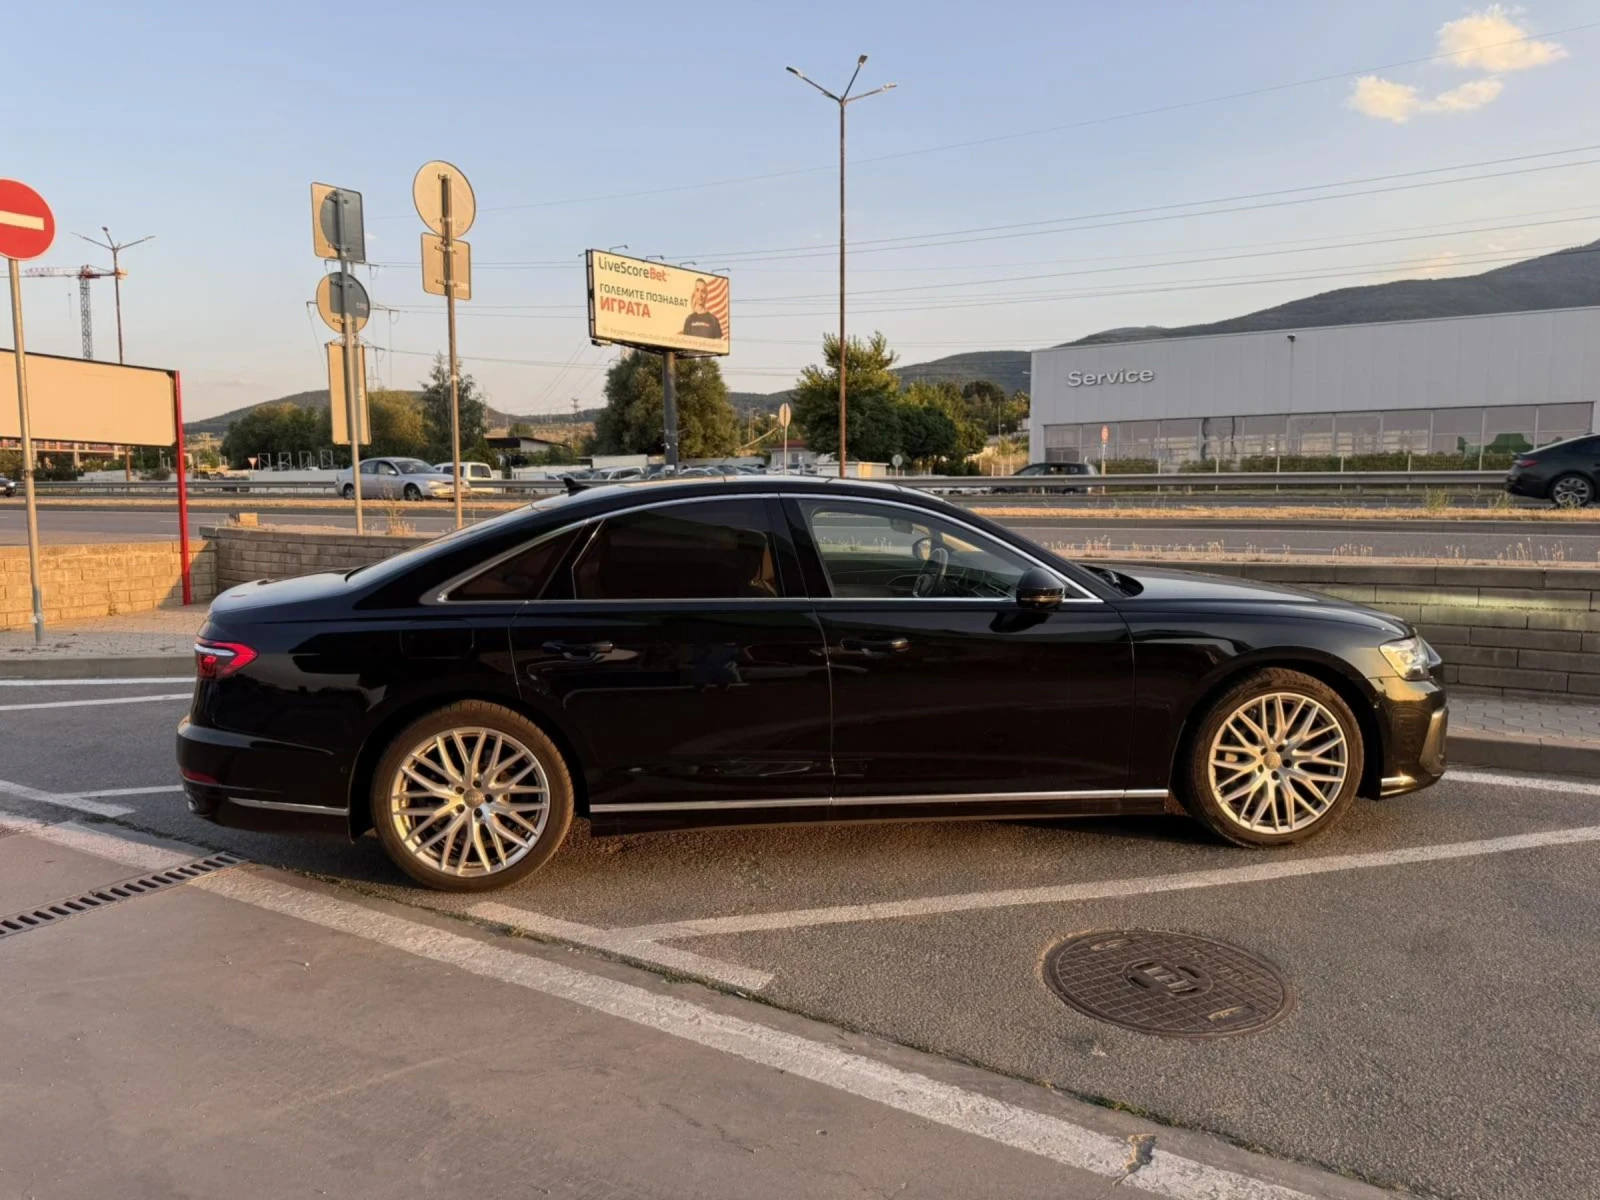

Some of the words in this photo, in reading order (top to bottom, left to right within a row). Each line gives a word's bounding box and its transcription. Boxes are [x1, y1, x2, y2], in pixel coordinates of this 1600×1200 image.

[598, 256, 668, 282] LiveScoreBet
[599, 283, 645, 299] ГОЛЕМИТЕ
[646, 293, 688, 307] ПОЗНАВАТ
[600, 296, 651, 318] ИГРАТА
[1067, 368, 1155, 387] Service
